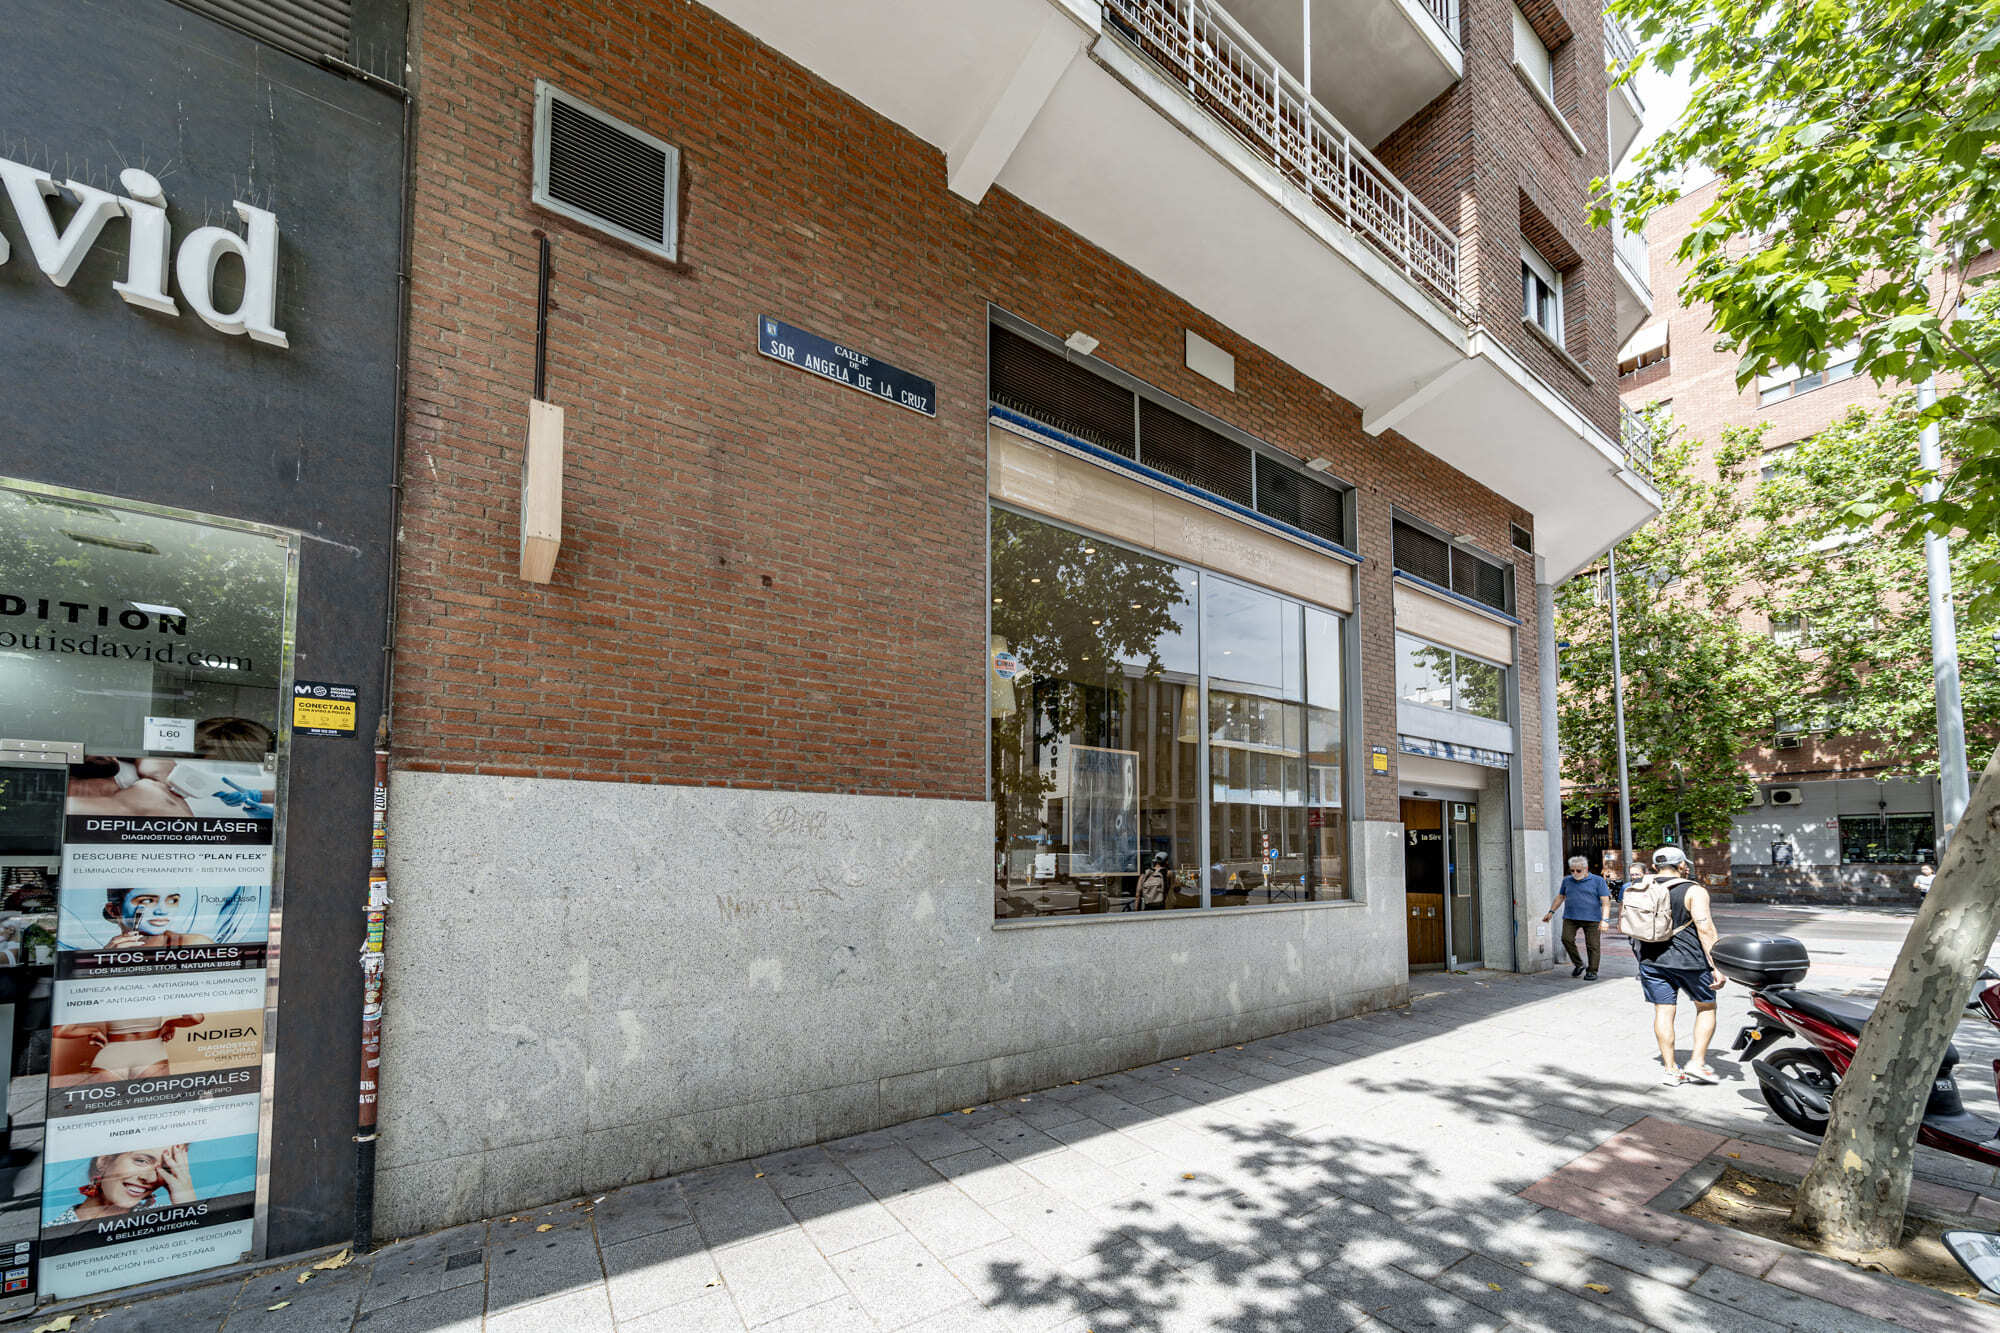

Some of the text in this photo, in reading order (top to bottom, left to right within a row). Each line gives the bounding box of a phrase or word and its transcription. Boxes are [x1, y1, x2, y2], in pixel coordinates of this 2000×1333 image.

[0, 157, 289, 349] vid
[834, 345, 869, 366] CALLE
[849, 361, 860, 371] DE
[771, 340, 928, 411] SOR ANGELA DE LA CRUZ
[0, 594, 187, 635] DITION
[0, 630, 253, 672] ouisdavid.com
[298, 702, 351, 711] CONECTADA
[86, 819, 258, 833] DEPILACIÓN LÁSER
[121, 833, 182, 841] DIAGNÓSTICO
[136, 866, 193, 874] PERMANENTE
[94, 947, 239, 965] TTOS. FACIALES
[110, 965, 152, 974] MEJORES
[180, 962, 215, 970] NATURA
[69, 986, 112, 994] LIMPIEZA
[113, 984, 145, 992] FACIAL
[151, 981, 199, 989] ANTIAGING
[105, 995, 156, 1004] ANTIAGING
[187, 1027, 257, 1042] INDIBA
[65, 1071, 251, 1102] TTOS. CORPORALES
[85, 1100, 122, 1110] REDUCE
[134, 1093, 183, 1104] REMODELA
[185, 1090, 196, 1098] TU
[197, 1086, 233, 1096] CUERPO
[137, 1109, 186, 1122] REDUCTOR
[98, 1204, 209, 1234] MANICURAS
[115, 1228, 155, 1241] BELLEZA
[156, 1220, 200, 1233] INTEGRAL
[56, 1249, 139, 1271] SEMIPERMANENTE
[172, 1239, 189, 1248] GEL
[194, 1228, 243, 1243] PEDICURAS
